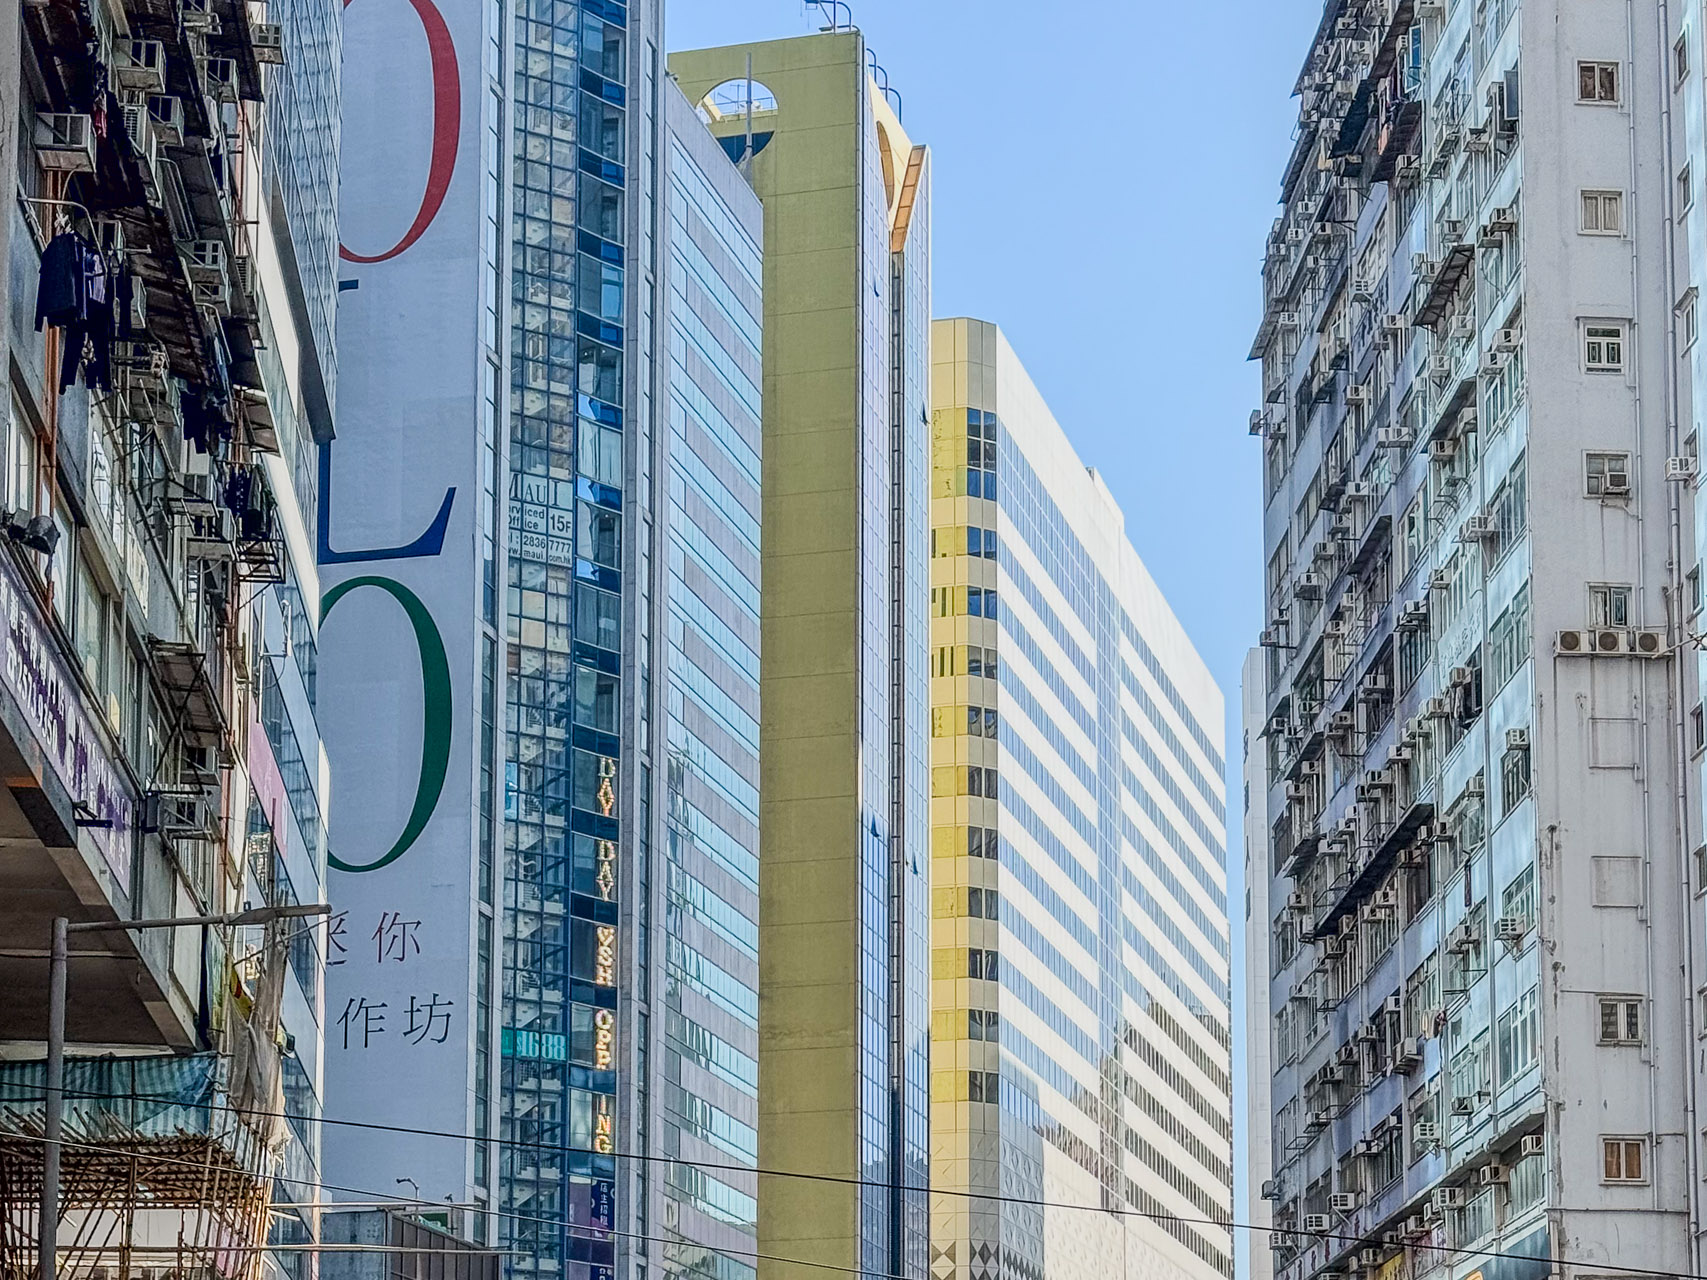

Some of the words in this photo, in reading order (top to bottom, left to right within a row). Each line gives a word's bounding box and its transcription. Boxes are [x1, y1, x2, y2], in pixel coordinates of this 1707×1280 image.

[550, 513, 571, 534] 15F
[523, 535, 546, 549] 2836
[549, 540, 571, 554] 7777
[336, 992, 455, 1051] 作坊
[516, 1030, 567, 1062] $1688
